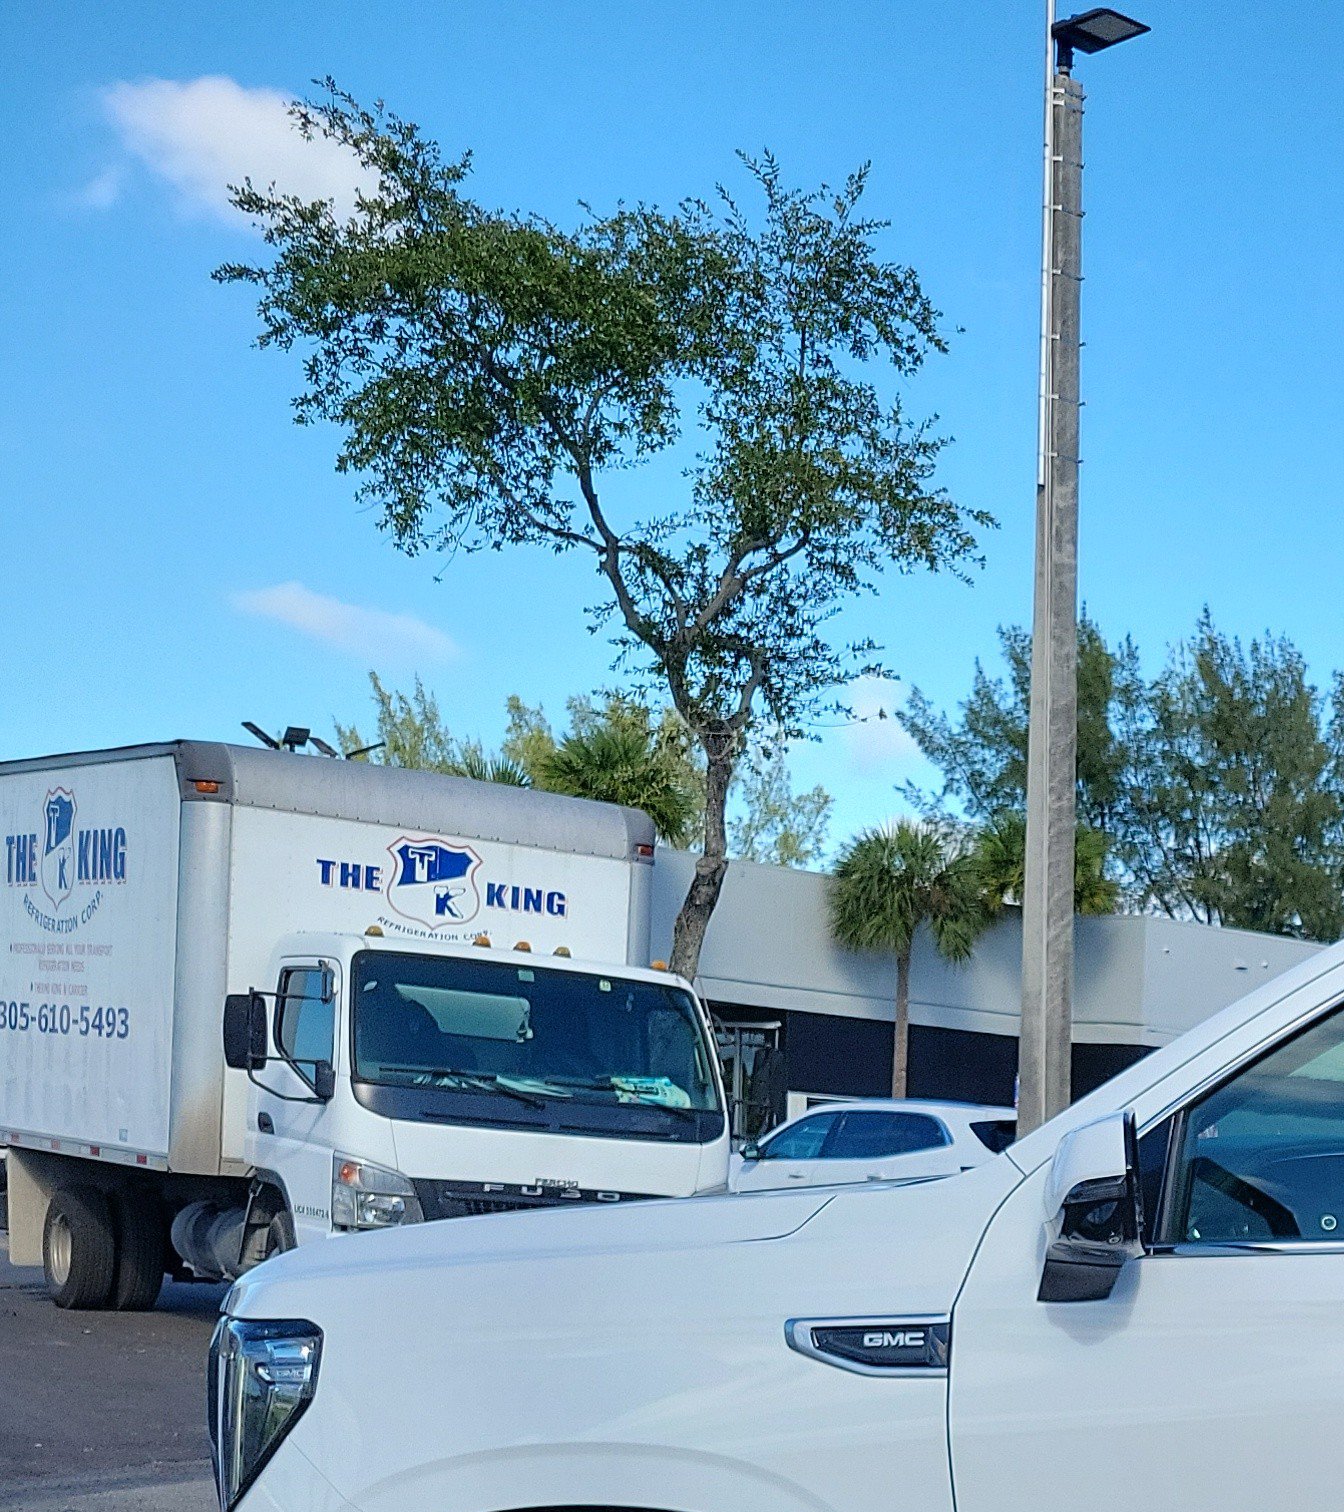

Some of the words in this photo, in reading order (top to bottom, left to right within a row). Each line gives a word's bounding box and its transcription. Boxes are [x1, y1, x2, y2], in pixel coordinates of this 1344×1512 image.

[6, 833, 38, 887] THE
[77, 826, 127, 885] KING
[316, 858, 384, 895] THE
[486, 881, 569, 919] KING
[23, 892, 78, 935] REFRIGERATION
[377, 915, 460, 942] REFRIGERATION
[0, 1000, 129, 1040] 305-610-5493
[484, 1182, 621, 1202] FUSO
[863, 1331, 925, 1347] GMC
